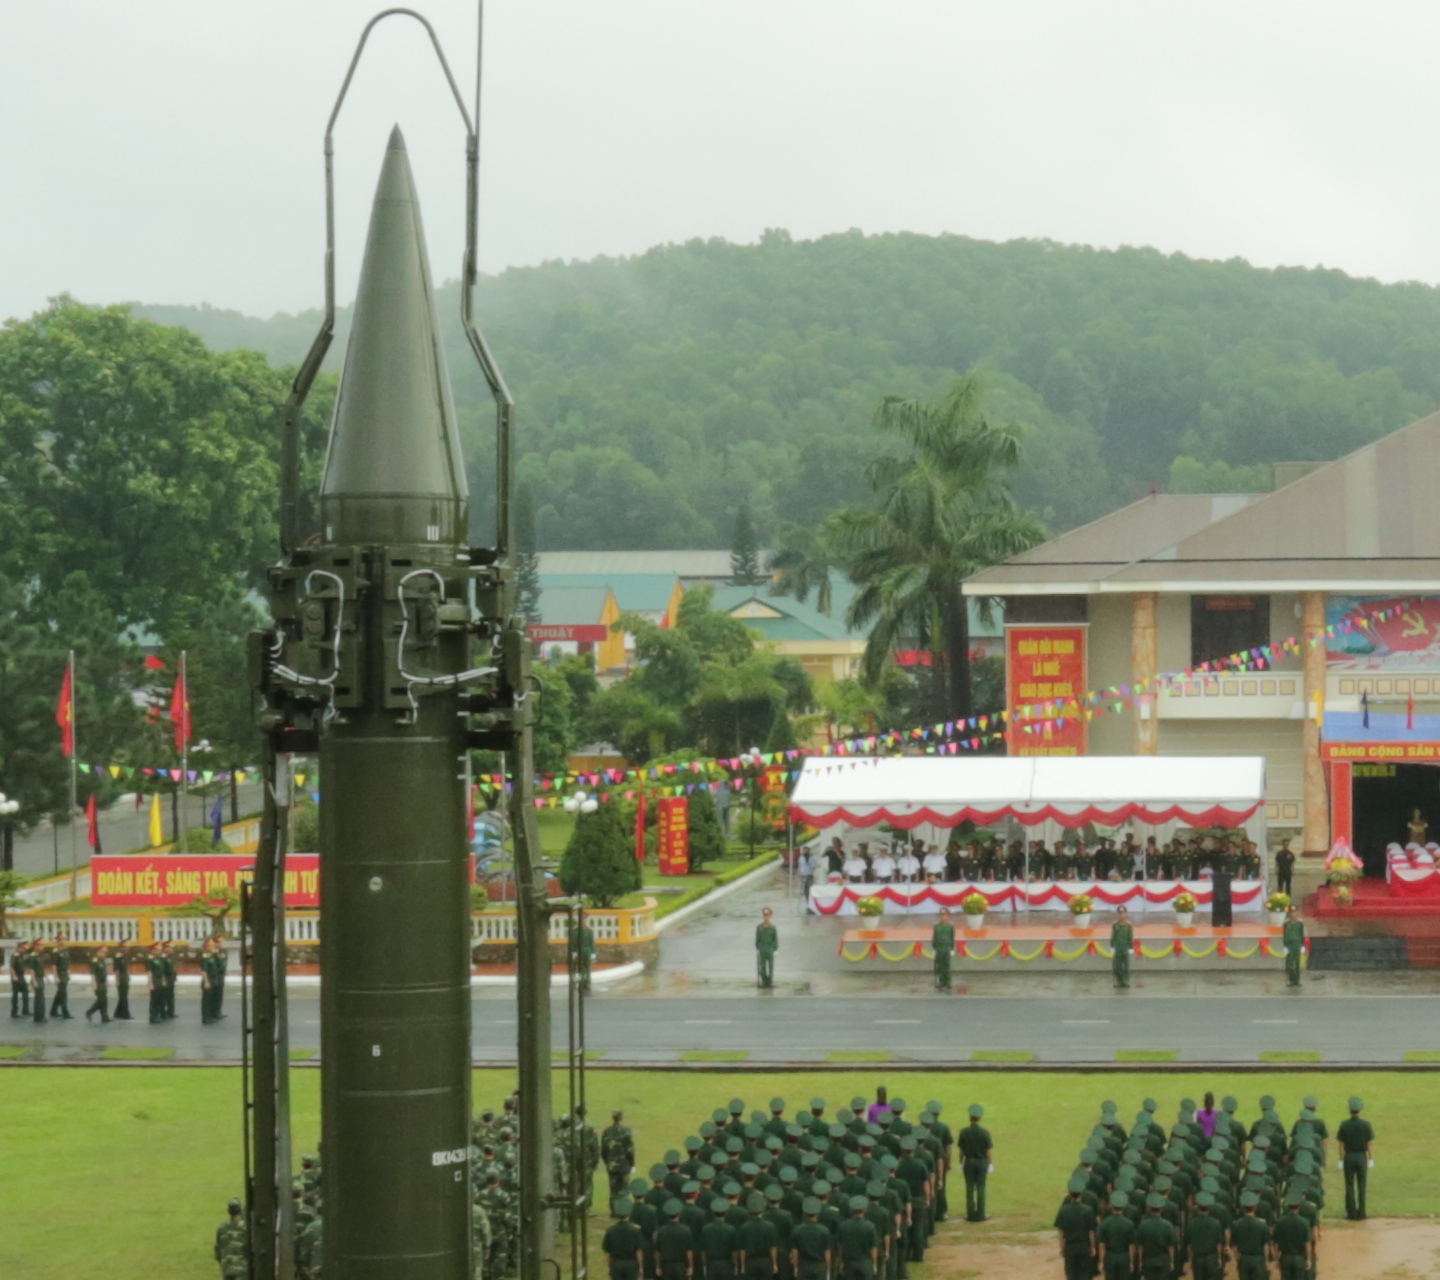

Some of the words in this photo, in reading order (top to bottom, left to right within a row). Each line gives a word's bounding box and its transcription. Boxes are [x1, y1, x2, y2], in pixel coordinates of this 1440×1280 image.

[1329, 743, 1365, 757] ĐẢNG
[1369, 745, 1404, 758] CỘNG
[1407, 743, 1434, 756] SẢN
[97, 866, 133, 895] ĐOÀN
[136, 863, 163, 897] KẾT,
[166, 866, 201, 895] SÁNG
